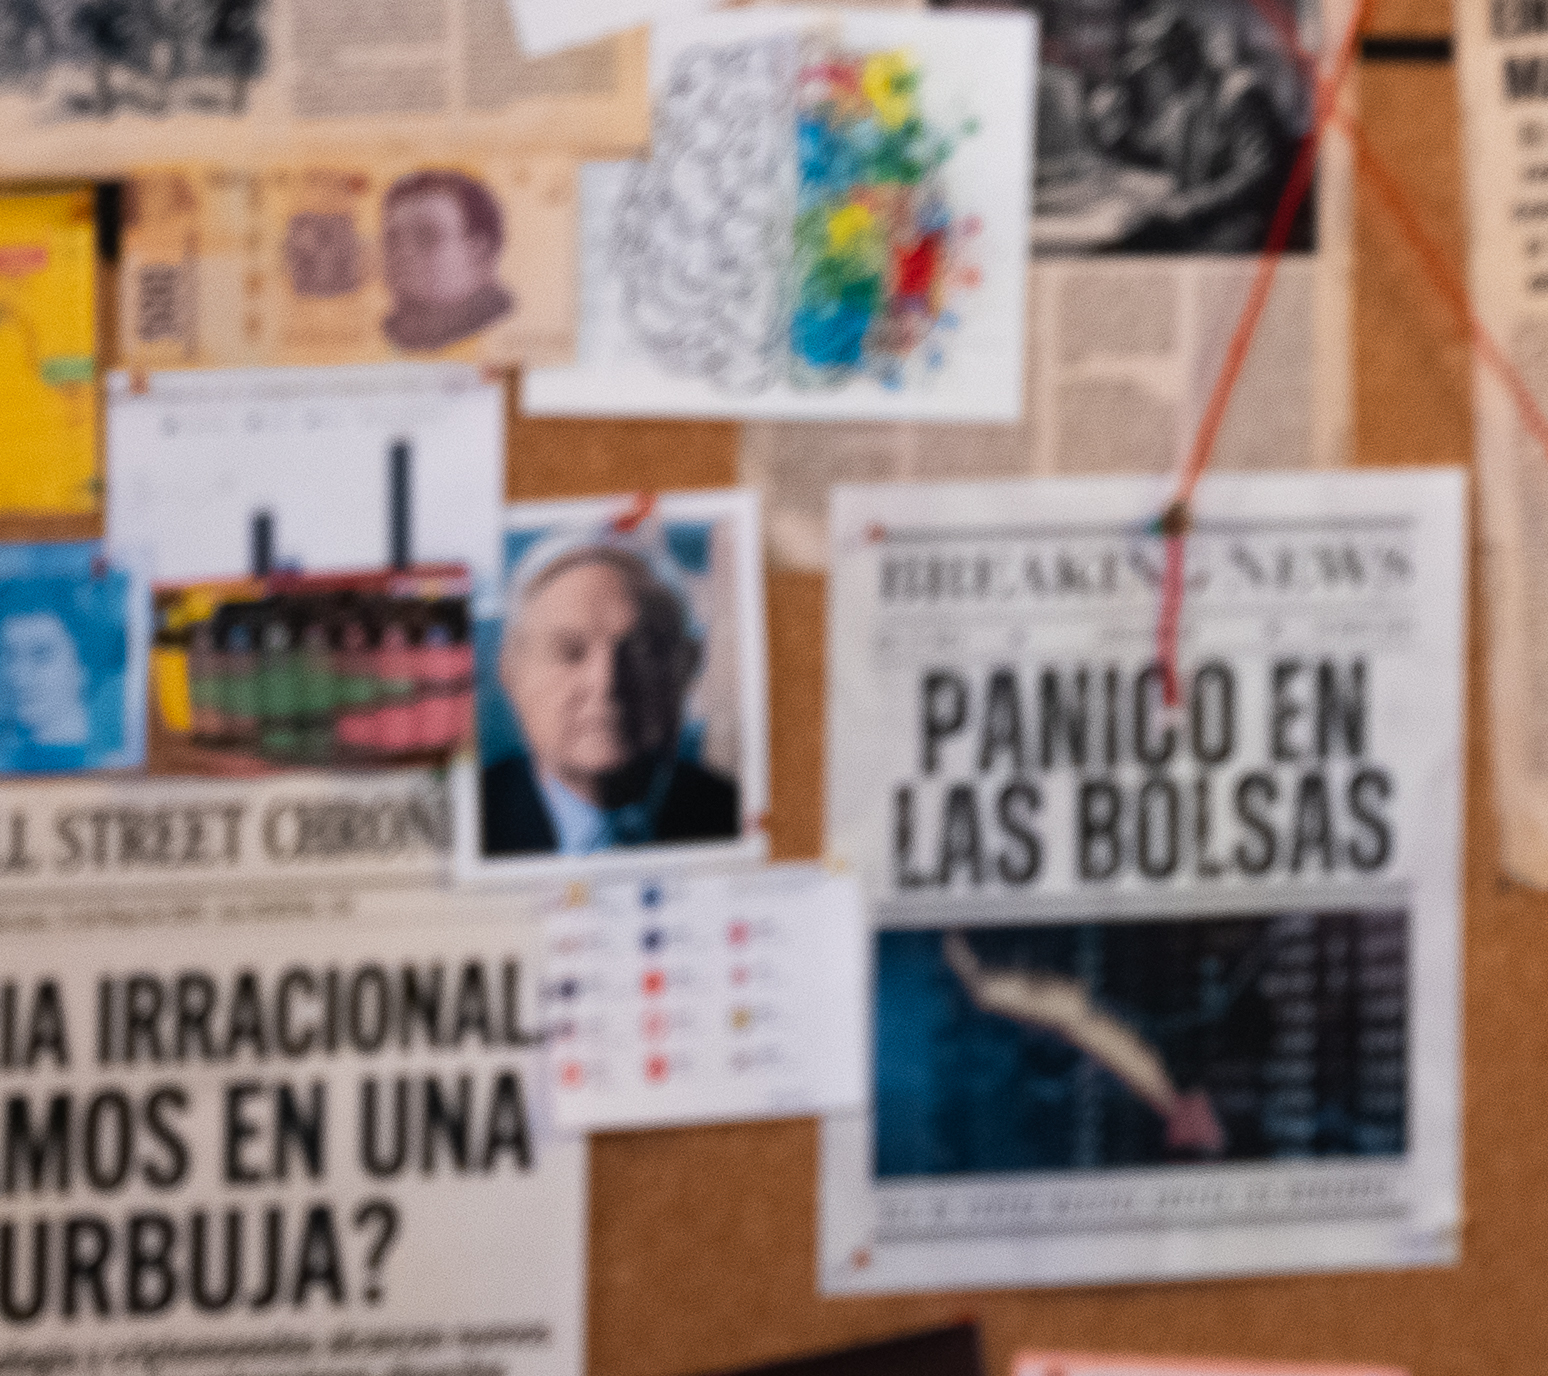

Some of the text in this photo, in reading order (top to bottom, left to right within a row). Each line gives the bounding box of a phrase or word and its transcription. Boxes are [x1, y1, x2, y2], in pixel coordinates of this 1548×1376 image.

[1271, 656, 1369, 763] EN
[894, 767, 1395, 893] LAS BOLSAS
[222, 1079, 326, 1187] EN
[359, 1070, 534, 1180] UNA
